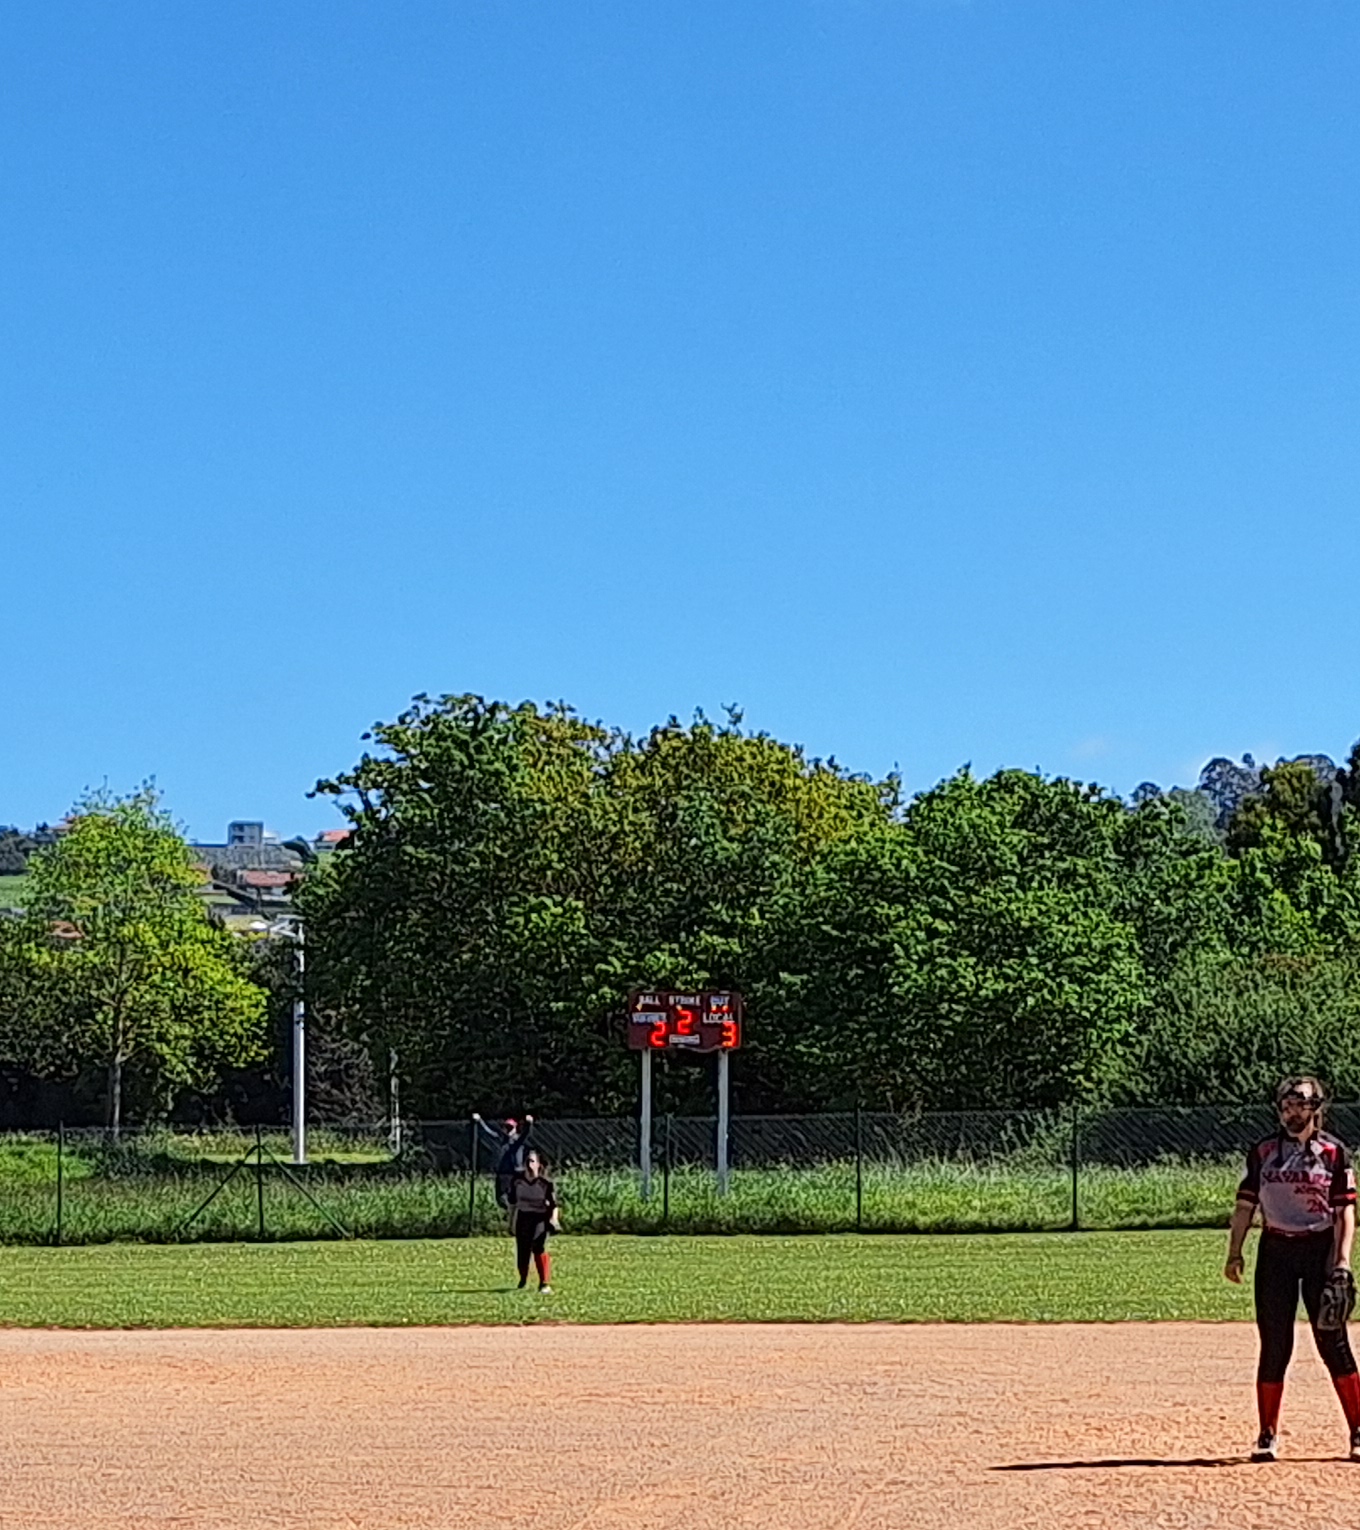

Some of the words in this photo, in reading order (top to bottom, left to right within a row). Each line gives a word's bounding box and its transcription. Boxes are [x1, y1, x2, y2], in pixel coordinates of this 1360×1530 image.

[650, 1021, 666, 1047] 2
[722, 1021, 738, 1047] 3
[677, 1010, 693, 1034] 2
